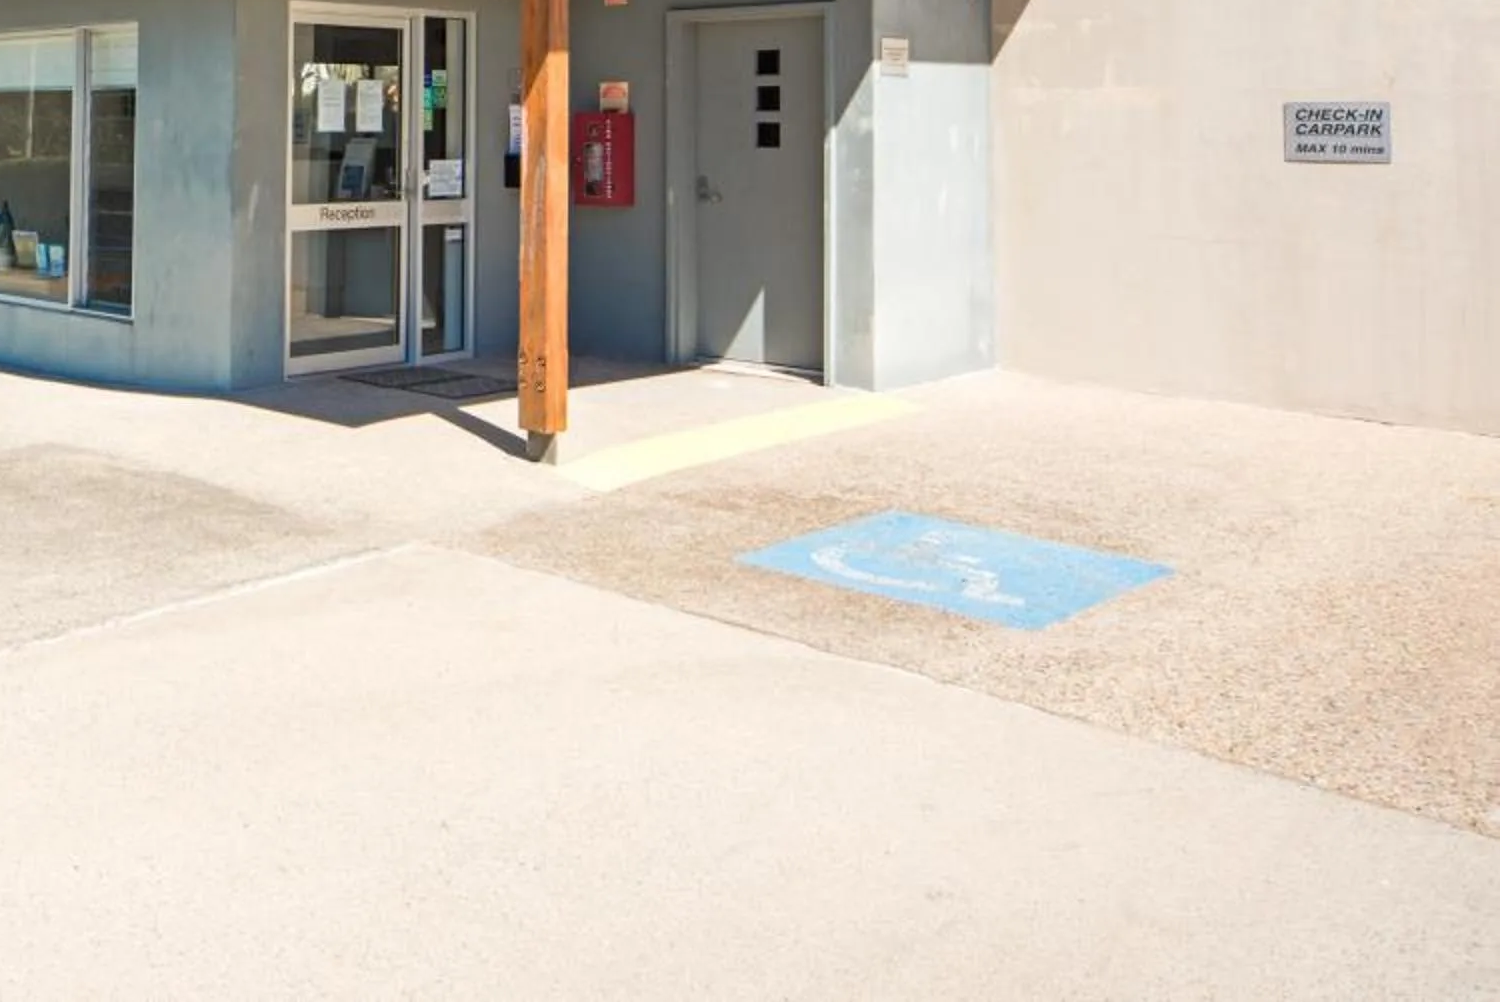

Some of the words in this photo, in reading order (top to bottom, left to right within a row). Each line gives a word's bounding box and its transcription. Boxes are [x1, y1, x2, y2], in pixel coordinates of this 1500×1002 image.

[1295, 108, 1383, 121] CHECK-IN
[1295, 123, 1382, 136] CARPARK
[1295, 143, 1327, 154] MAX
[1332, 144, 1347, 154] 10
[1350, 145, 1385, 155] mins
[320, 206, 376, 223] Reception
